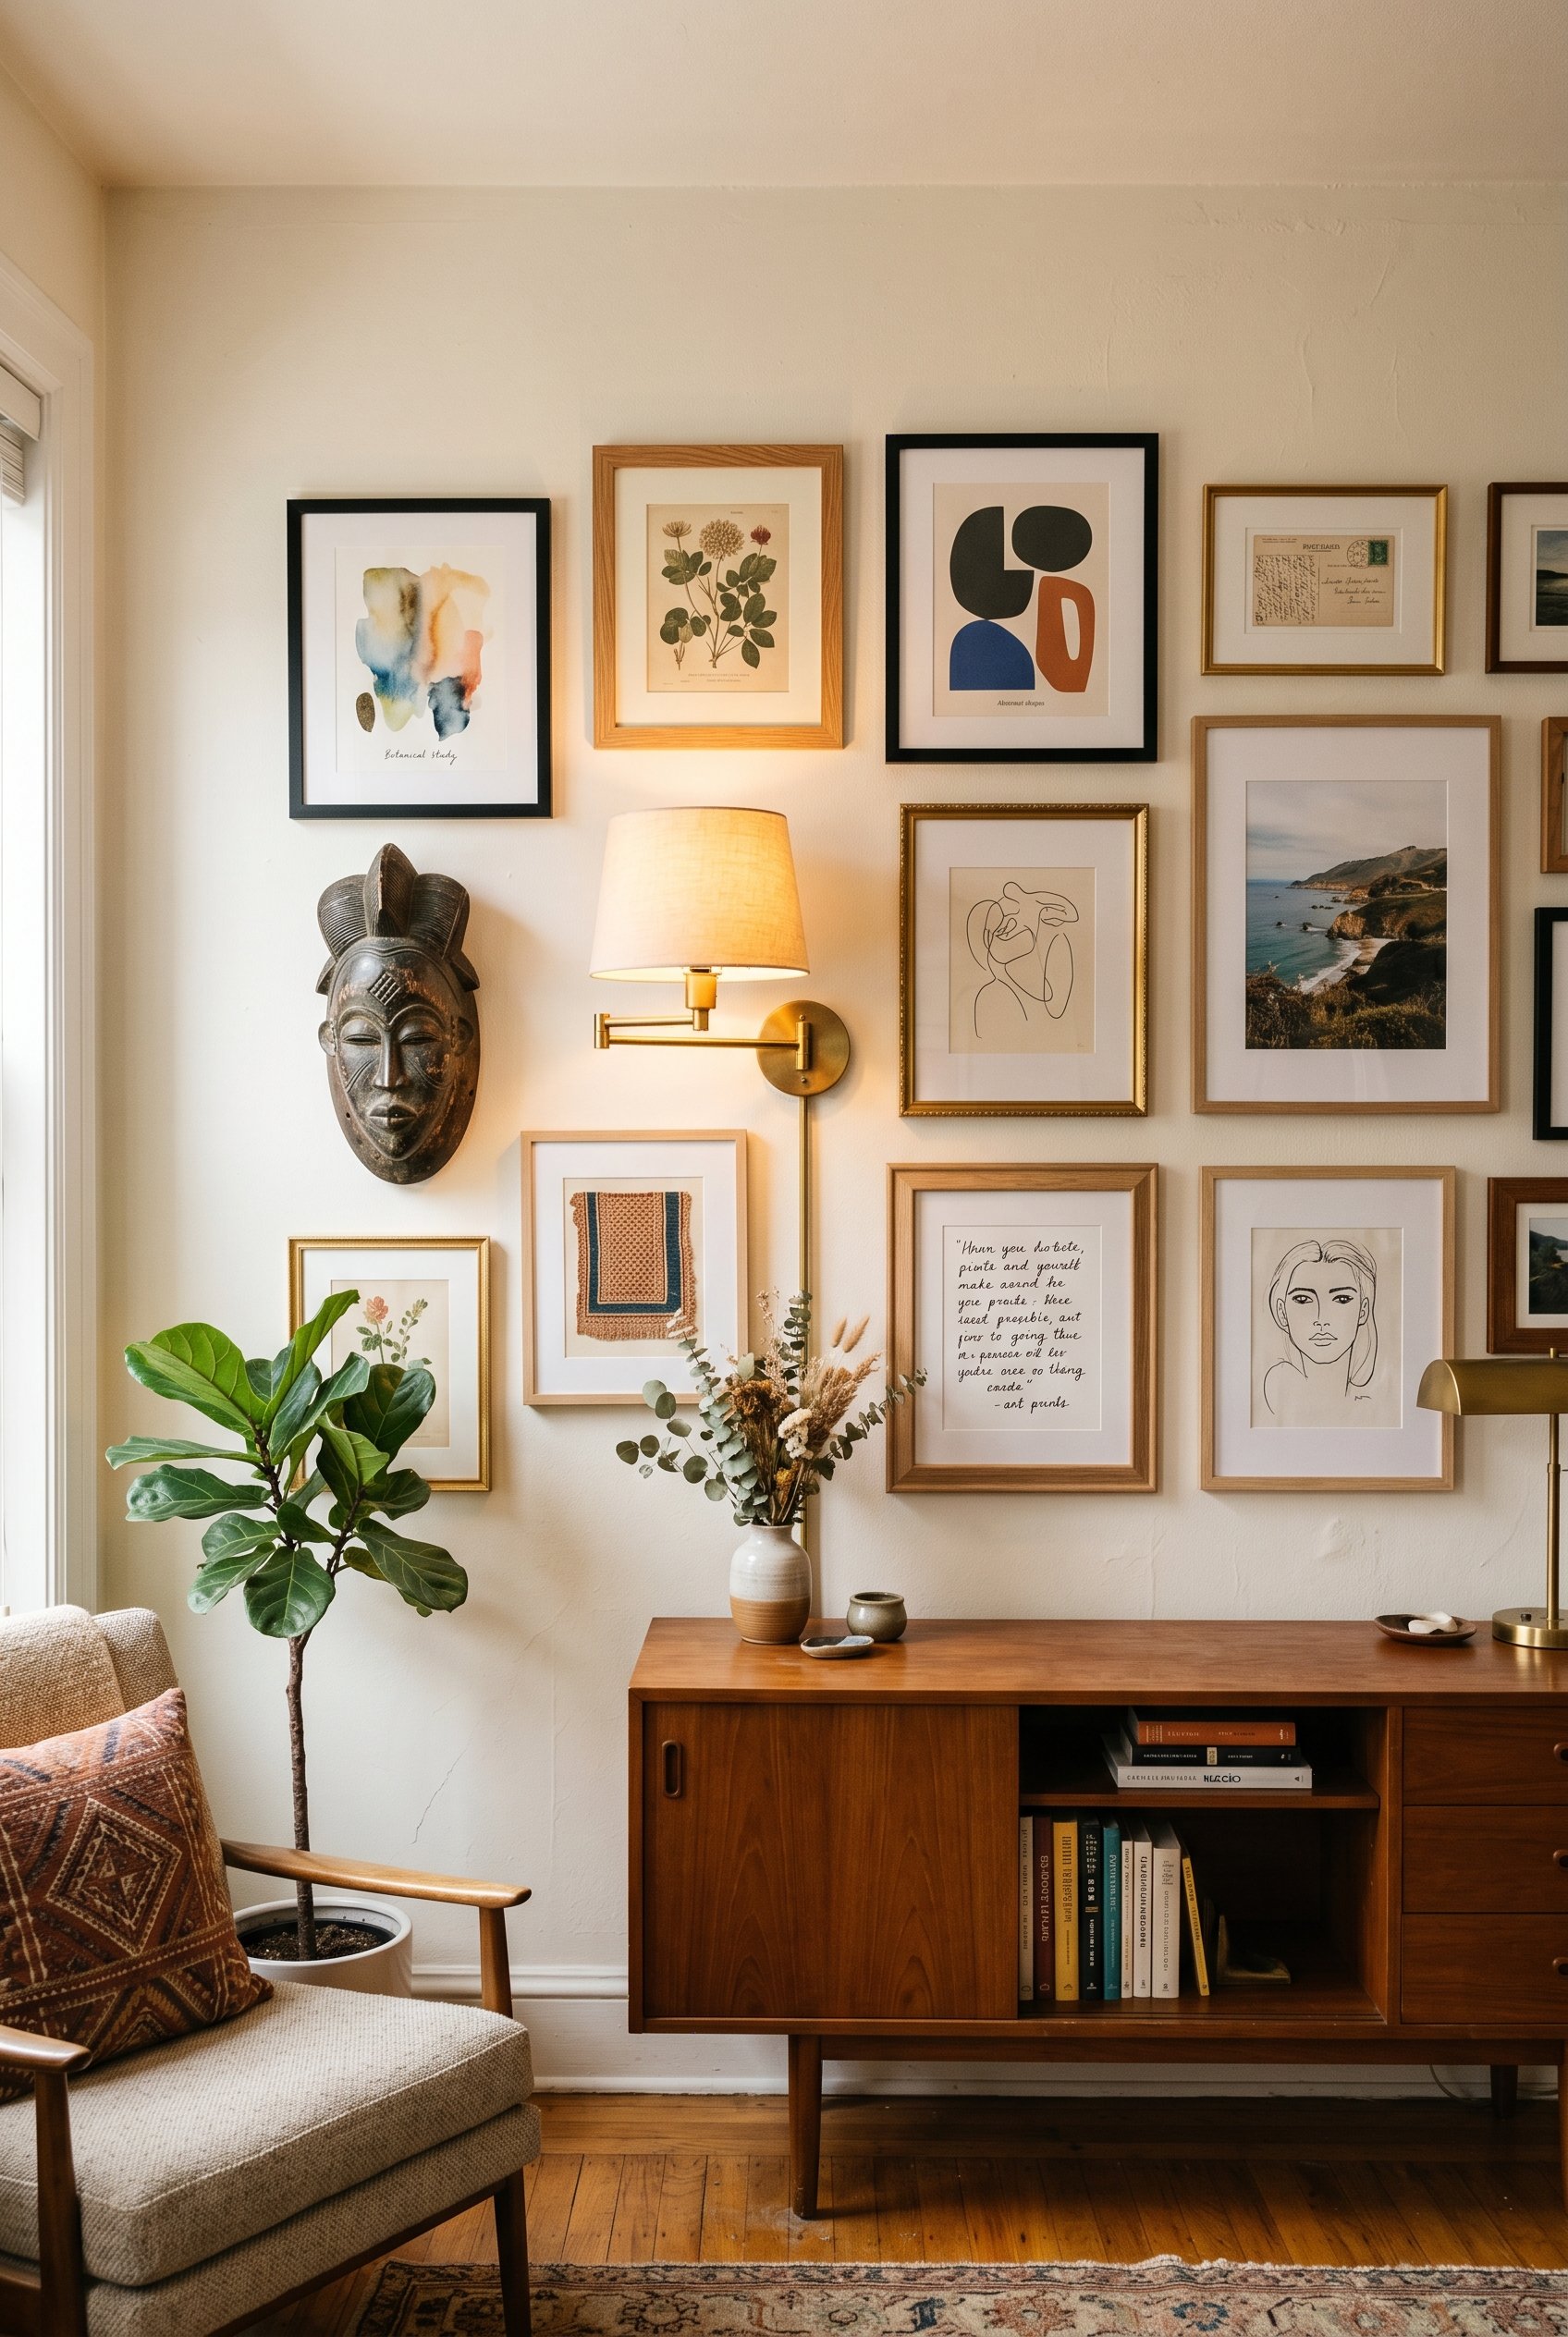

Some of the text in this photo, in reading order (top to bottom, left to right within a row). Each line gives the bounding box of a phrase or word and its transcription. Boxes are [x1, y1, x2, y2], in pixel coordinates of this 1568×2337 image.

[385, 748, 426, 760] Botanical
[1003, 1259, 1029, 1271] and
[958, 1279, 994, 1290] make
[990, 1332, 1001, 1340] to
